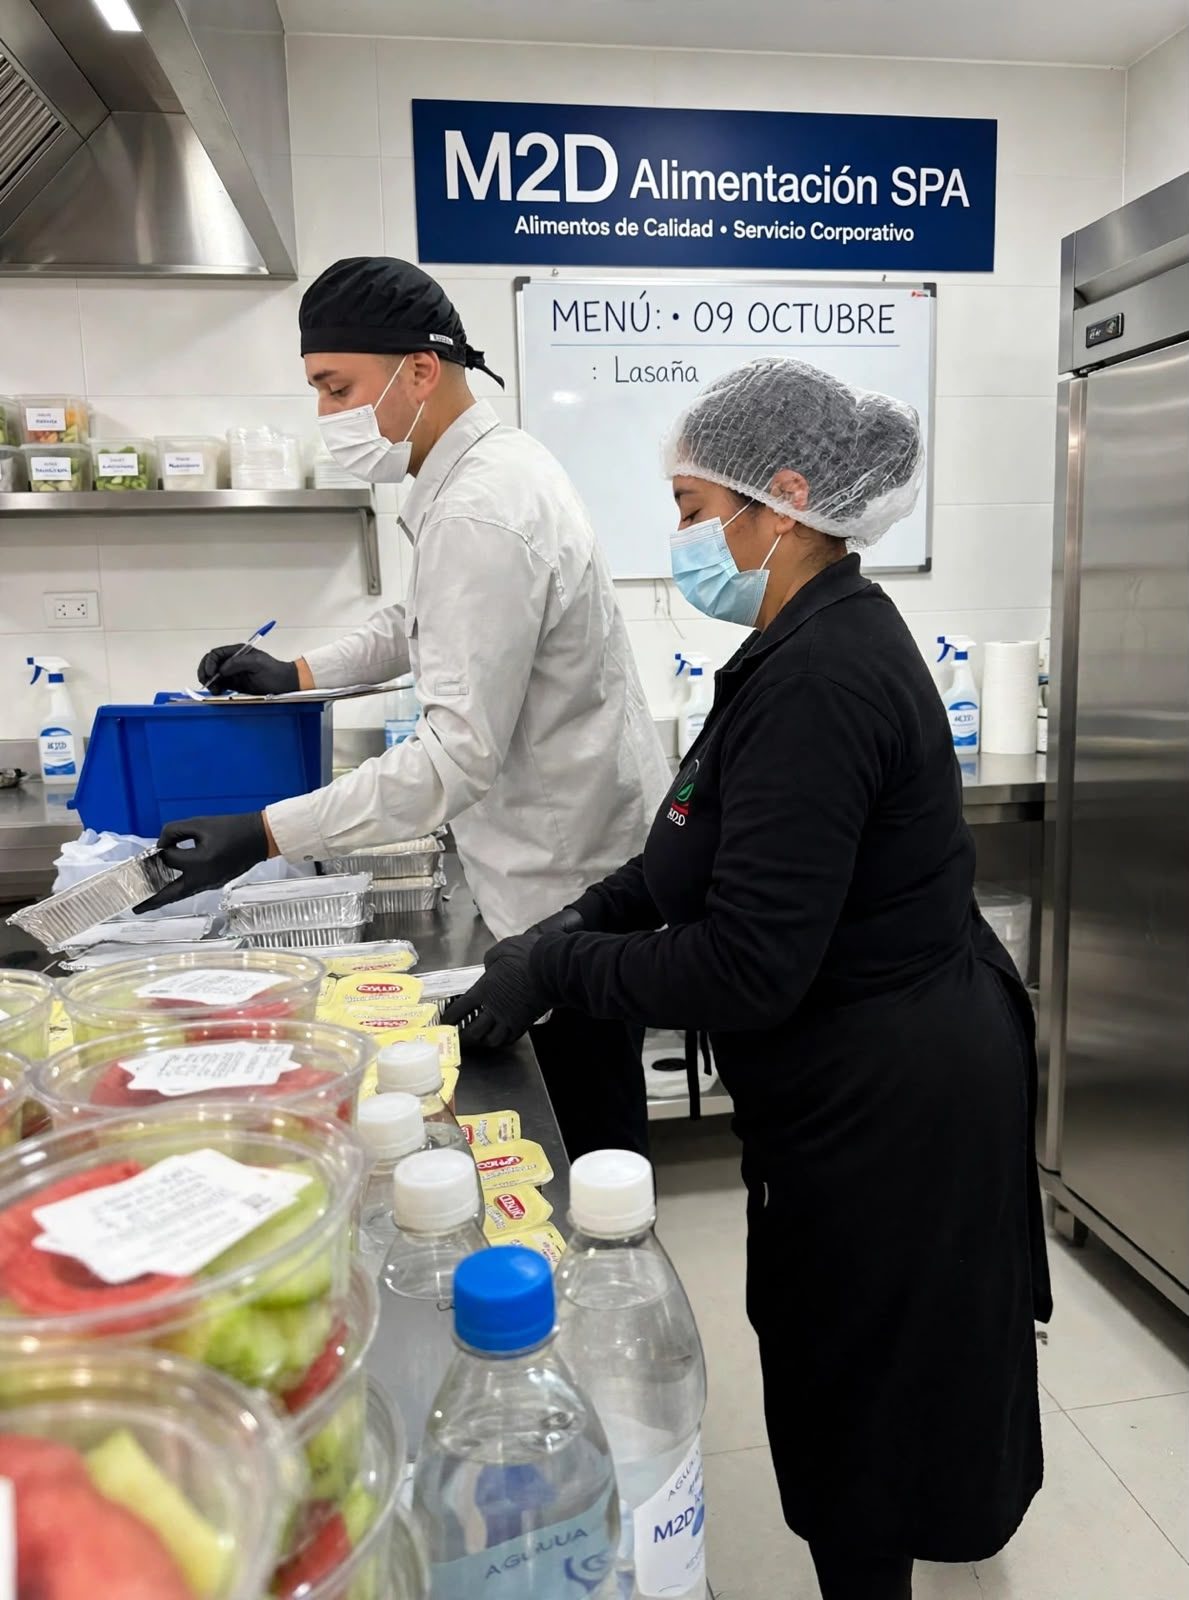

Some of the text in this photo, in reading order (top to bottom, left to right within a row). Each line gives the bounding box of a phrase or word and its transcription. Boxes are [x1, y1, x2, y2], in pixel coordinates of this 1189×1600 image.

[444, 130, 970, 208] M2D Alimentación SPA
[514, 215, 915, 245] Alimentos de Calidad Servicio Corporativo
[552, 289, 896, 335] MENÚ: 09 OCTUBRE
[614, 355, 699, 383] Lasaña
[653, 1506, 695, 1544] M2D
